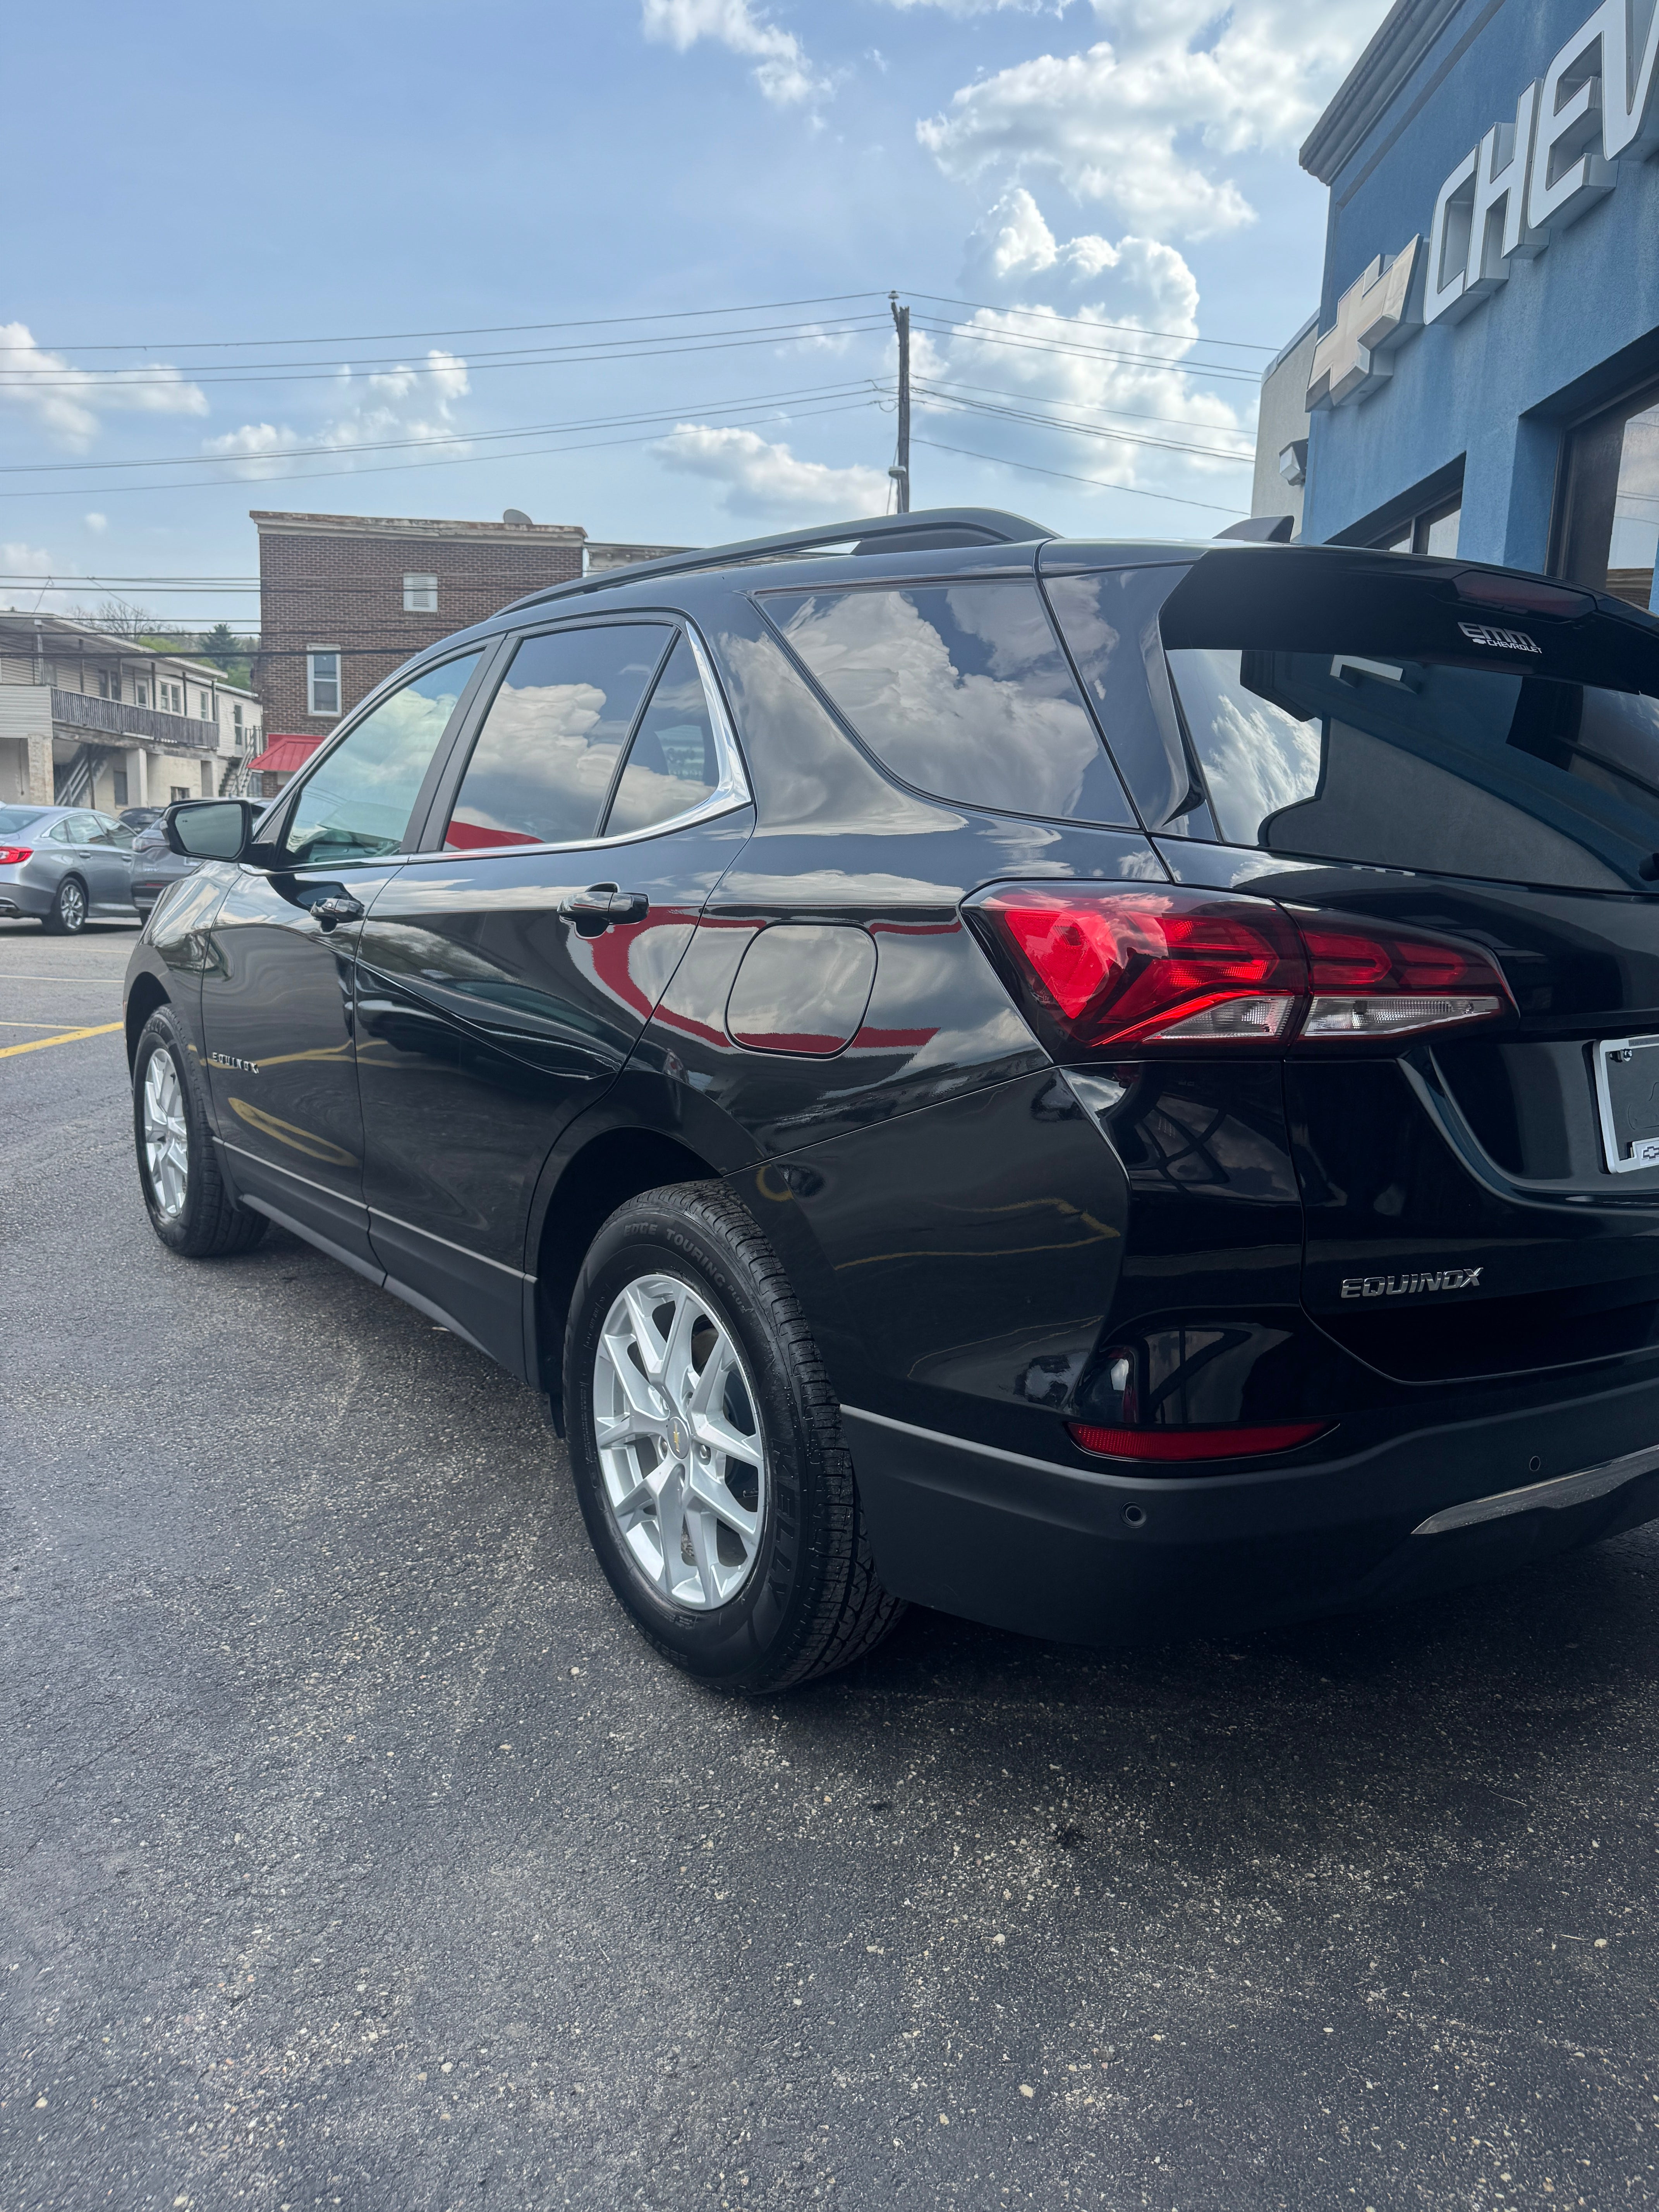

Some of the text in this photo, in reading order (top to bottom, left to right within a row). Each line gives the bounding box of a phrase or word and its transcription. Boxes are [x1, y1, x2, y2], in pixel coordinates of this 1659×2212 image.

[1486, 638, 1543, 654] CHEVROLET
[212, 1052, 259, 1074] EQUINOX
[623, 1222, 658, 1237] EDGE
[666, 1228, 726, 1288] TOURING
[1340, 1267, 1484, 1298] EQUINOX
[768, 1438, 796, 1613] KELLY
